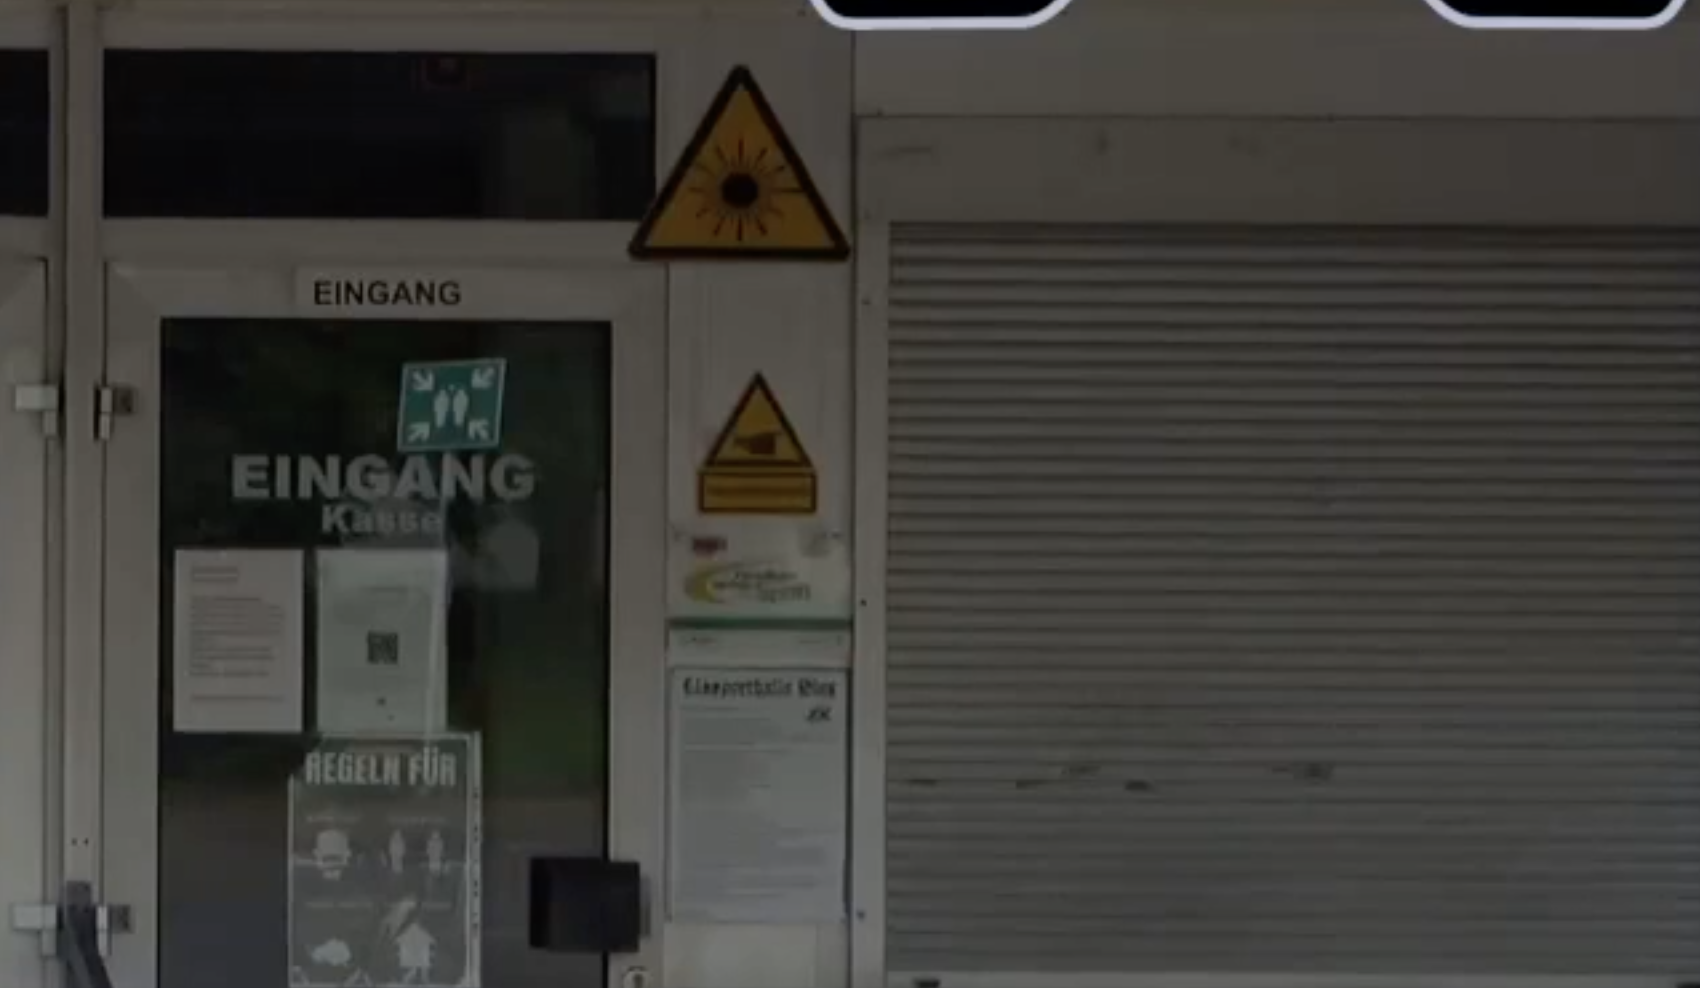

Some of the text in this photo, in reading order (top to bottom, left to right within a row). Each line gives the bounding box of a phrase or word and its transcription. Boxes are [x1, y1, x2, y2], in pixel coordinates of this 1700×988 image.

[313, 278, 463, 307] EINGANG
[232, 454, 536, 500] EINGANG
[322, 504, 442, 534] Kasse
[306, 747, 457, 787] REGELN FÜR
